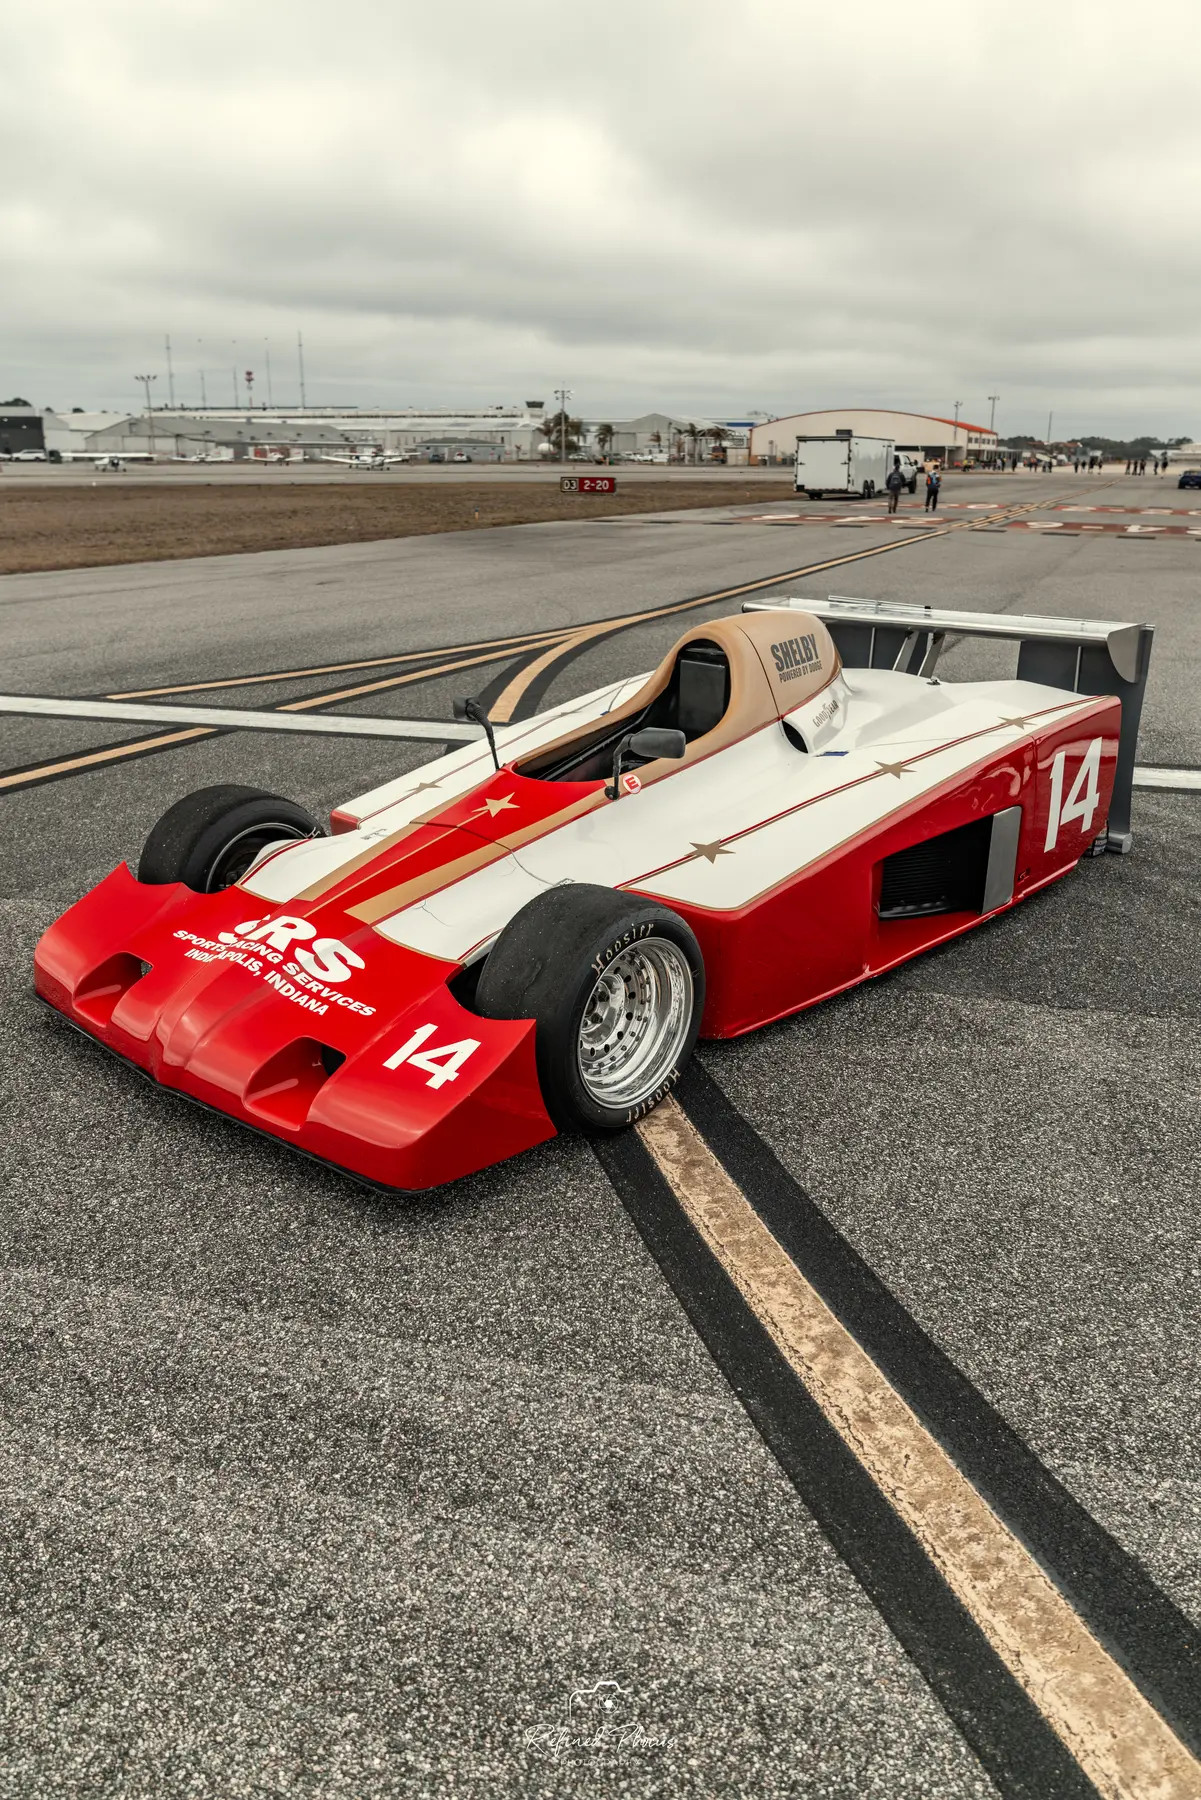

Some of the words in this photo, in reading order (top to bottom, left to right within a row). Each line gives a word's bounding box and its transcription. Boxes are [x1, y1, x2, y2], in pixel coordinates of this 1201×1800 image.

[564, 480, 577, 490] D3
[583, 480, 610, 490] 2-20
[770, 633, 819, 672] SHELBY
[779, 666, 802, 683] POWERED
[802, 664, 809, 676] BY
[809, 660, 823, 673] DODGE
[812, 700, 839, 728] GOODYEAR
[625, 776, 639, 790] E
[1043, 736, 1102, 853] 14
[230, 940, 284, 964] ACING
[282, 962, 377, 1016] SERVICES
[263, 970, 329, 1016] INDIANA
[382, 1023, 482, 1090] 14
